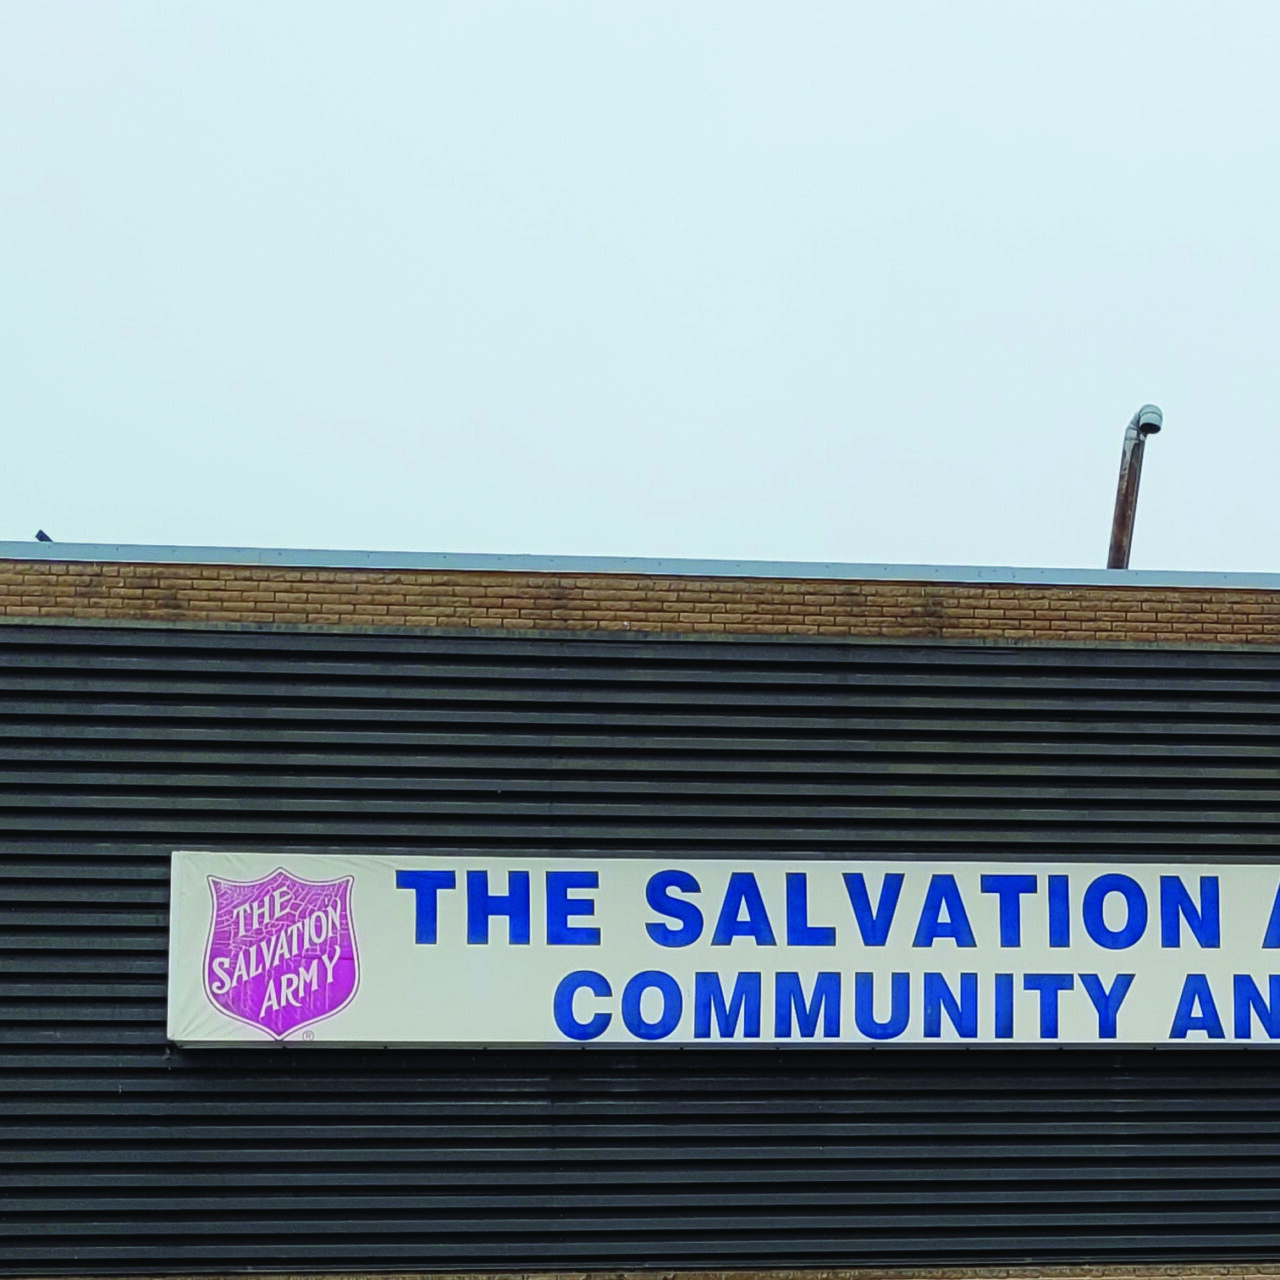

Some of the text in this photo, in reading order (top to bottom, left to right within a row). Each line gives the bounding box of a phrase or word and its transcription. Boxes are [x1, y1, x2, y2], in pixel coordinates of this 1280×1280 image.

[211, 897, 341, 995] SALVATION
[233, 886, 292, 938] THE
[395, 868, 602, 946] THE
[644, 868, 1221, 951] SALVATION
[259, 945, 341, 1019] ARMY
[553, 969, 1134, 1042] COMMUNITY
